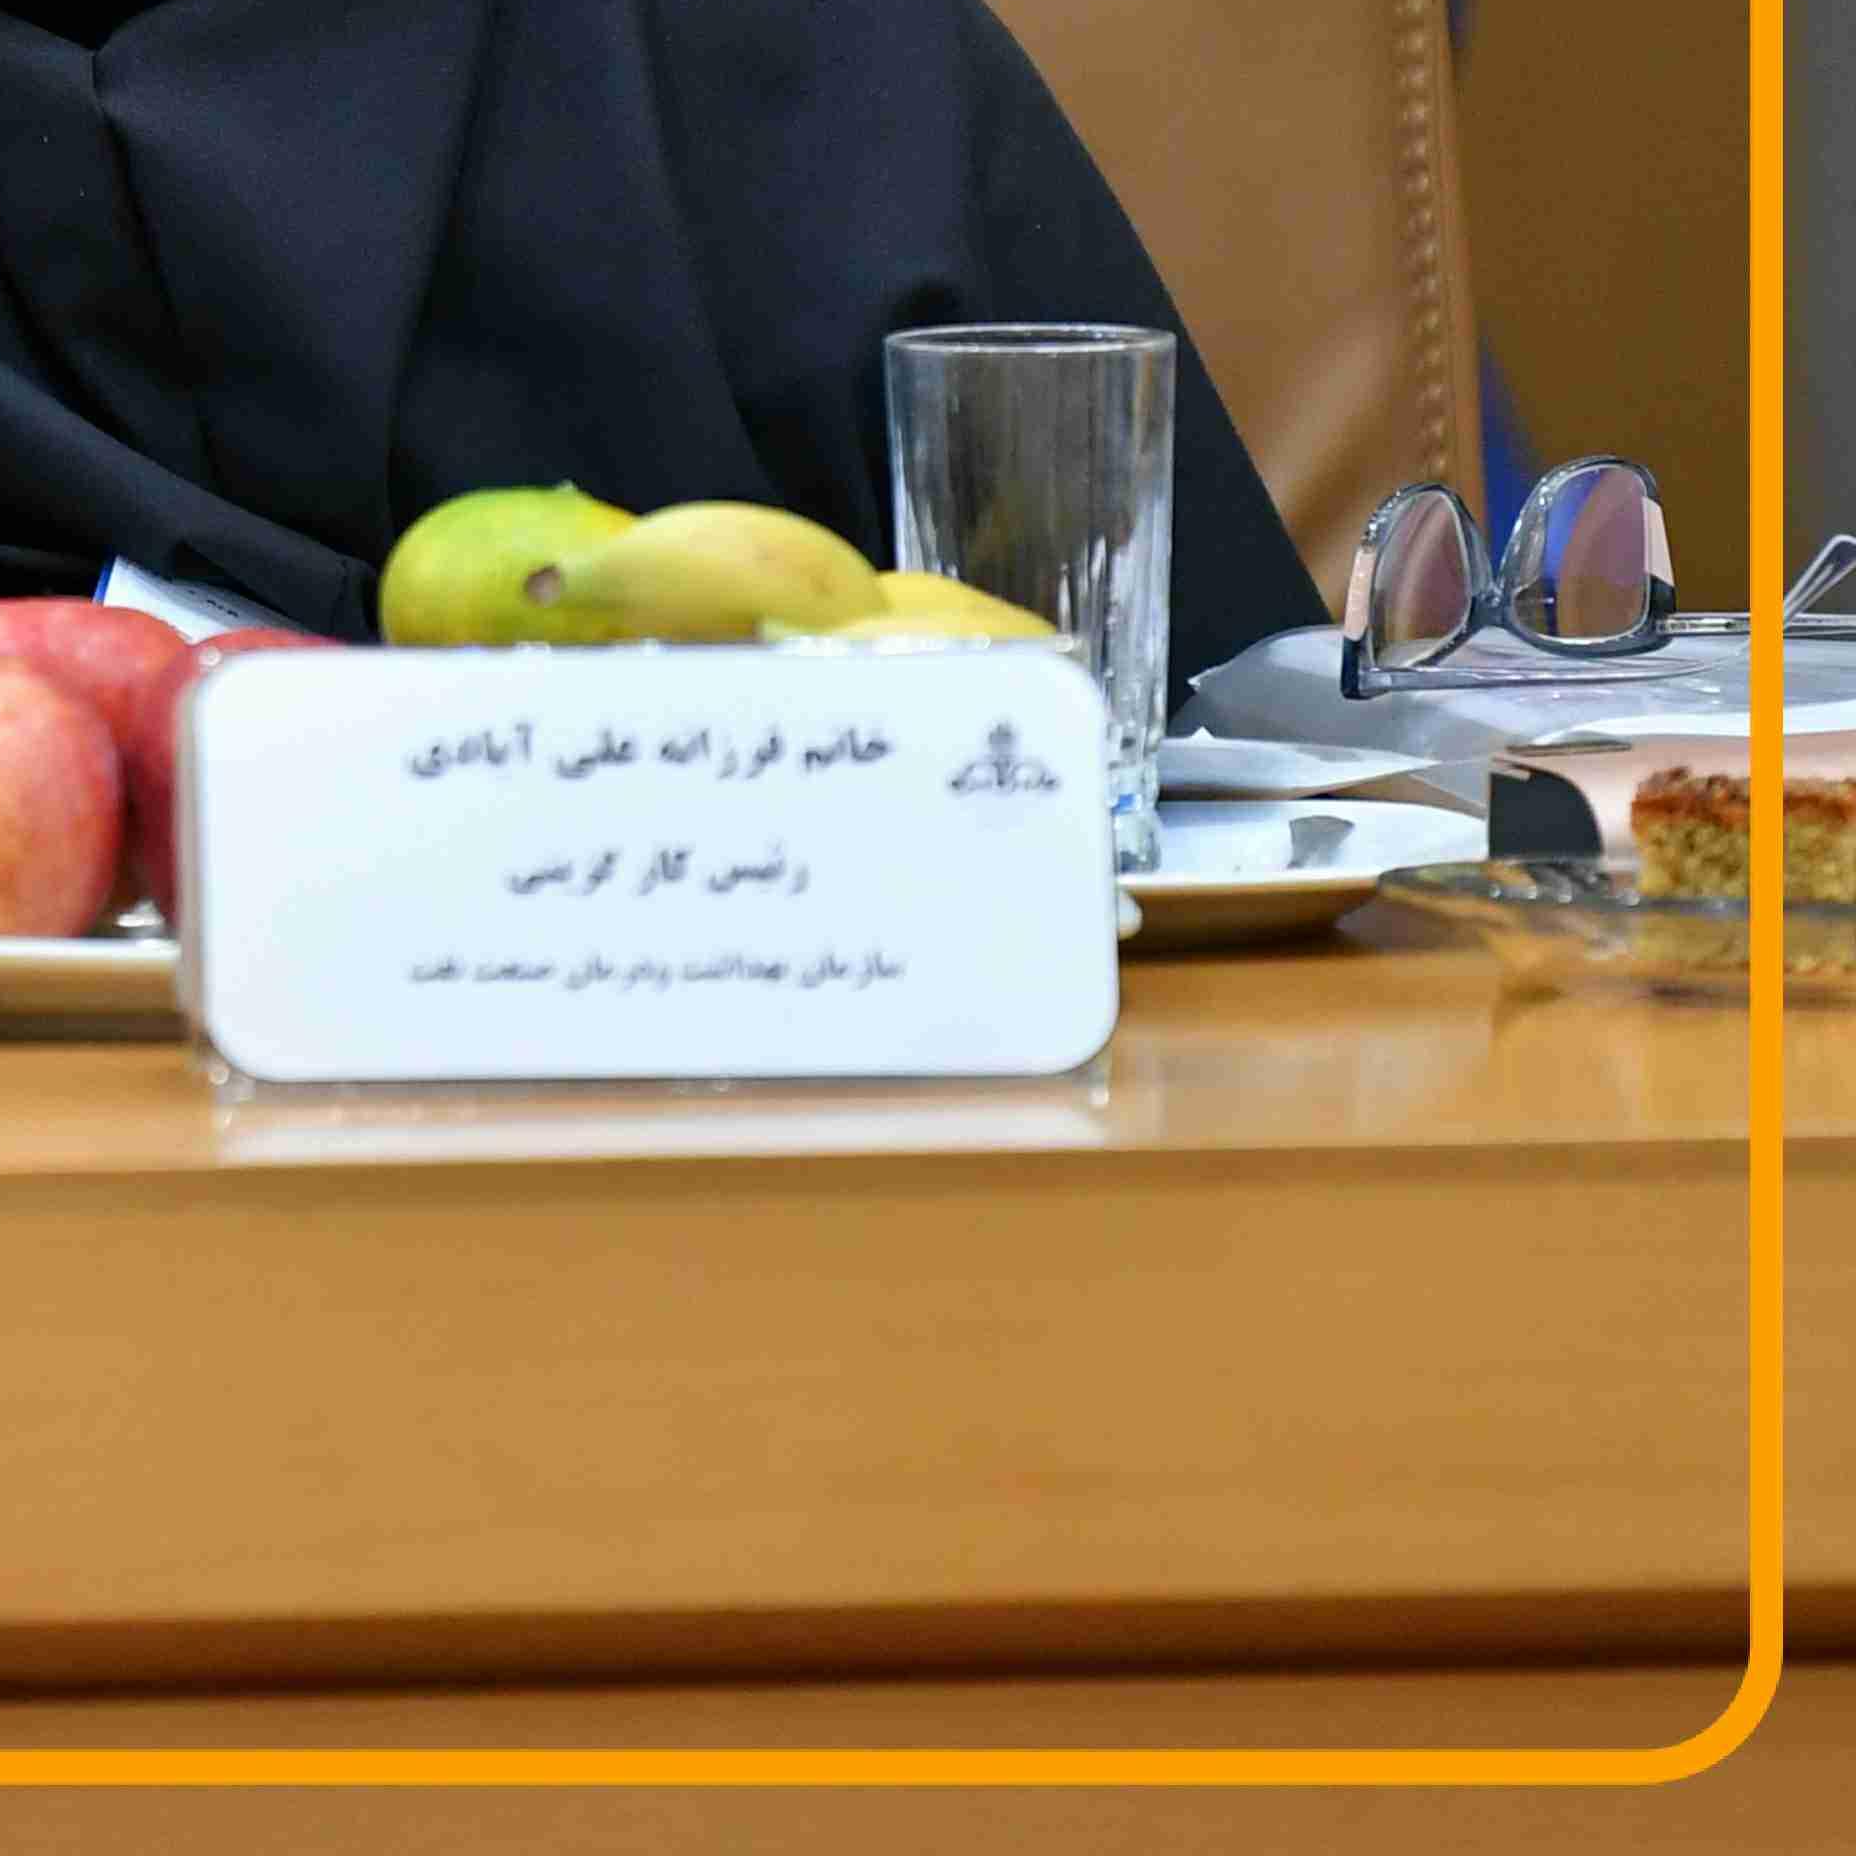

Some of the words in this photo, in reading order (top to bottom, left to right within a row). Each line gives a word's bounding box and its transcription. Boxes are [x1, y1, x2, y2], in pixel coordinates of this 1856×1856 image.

[405, 718, 534, 782] آبادی
[551, 725, 641, 783] علی
[654, 723, 787, 782] فرزانه
[797, 723, 896, 775] خانم
